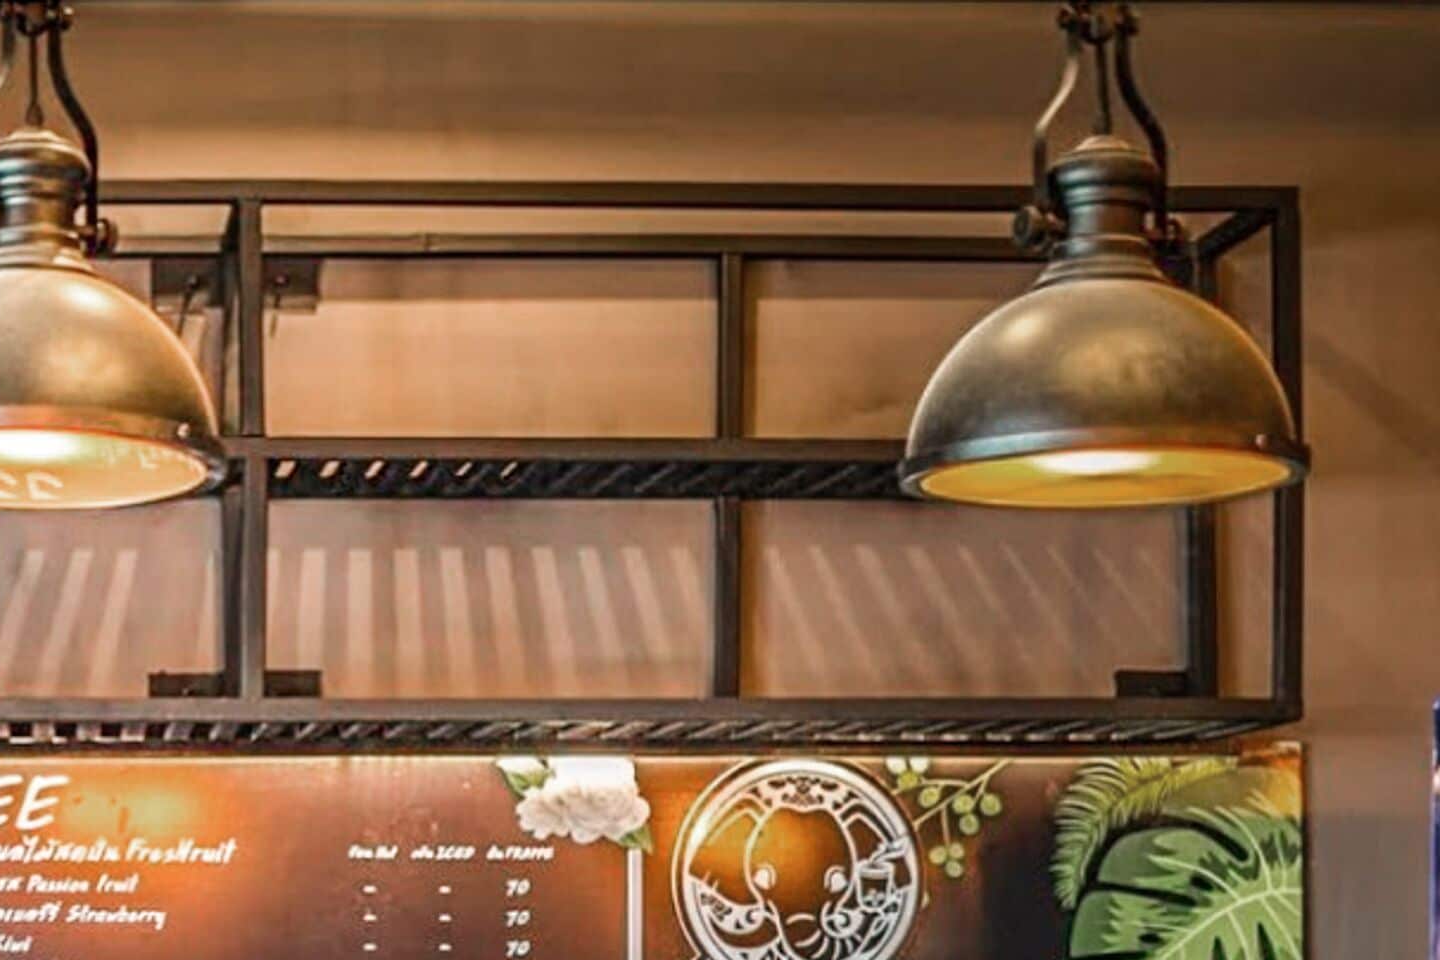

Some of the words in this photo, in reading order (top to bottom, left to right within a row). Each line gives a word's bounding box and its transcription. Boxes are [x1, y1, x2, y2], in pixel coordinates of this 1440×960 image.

[507, 880, 529, 896] 70
[66, 904, 165, 930] Strawberry
[506, 911, 530, 927] 70
[506, 941, 530, 957] 70
